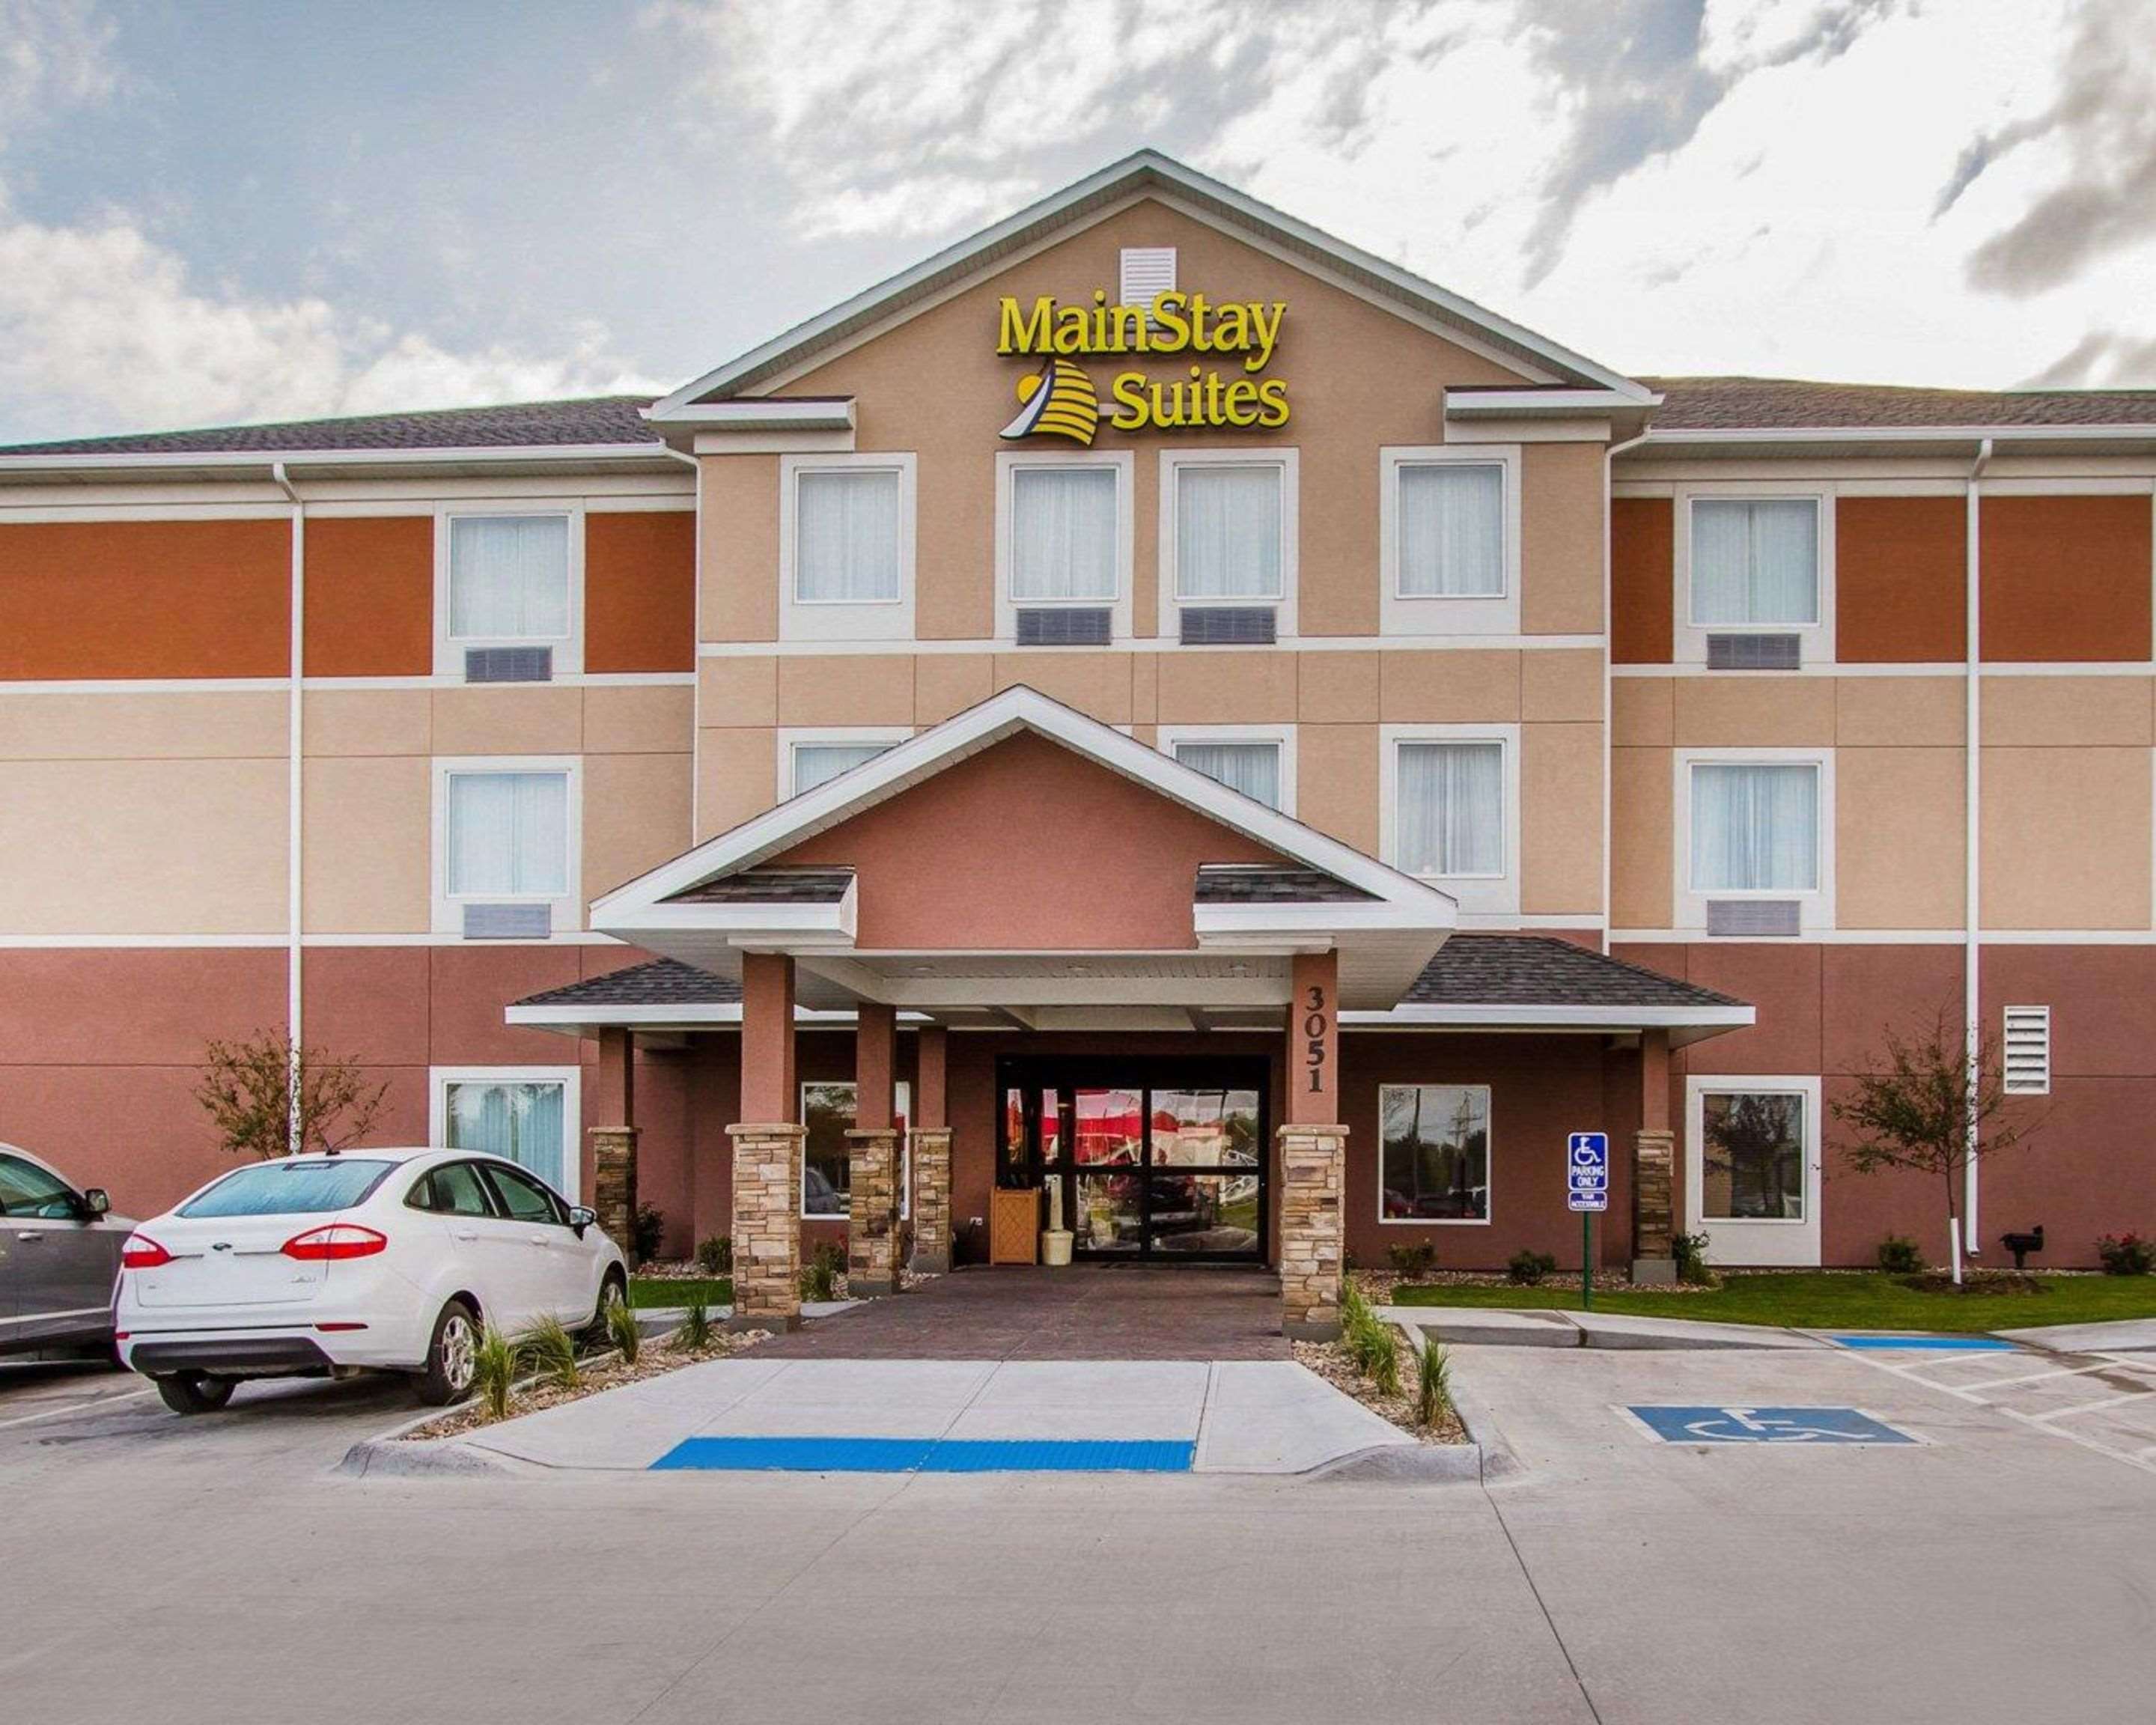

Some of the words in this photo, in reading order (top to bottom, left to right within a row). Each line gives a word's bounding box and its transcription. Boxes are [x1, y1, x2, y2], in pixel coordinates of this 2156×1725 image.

[996, 289, 1288, 373] MainStay
[1111, 365, 1290, 431] Suites
[1305, 986, 1327, 1093] 3051
[1571, 1166, 1604, 1177] PARKING
[1577, 1176, 1598, 1187] ONLY
